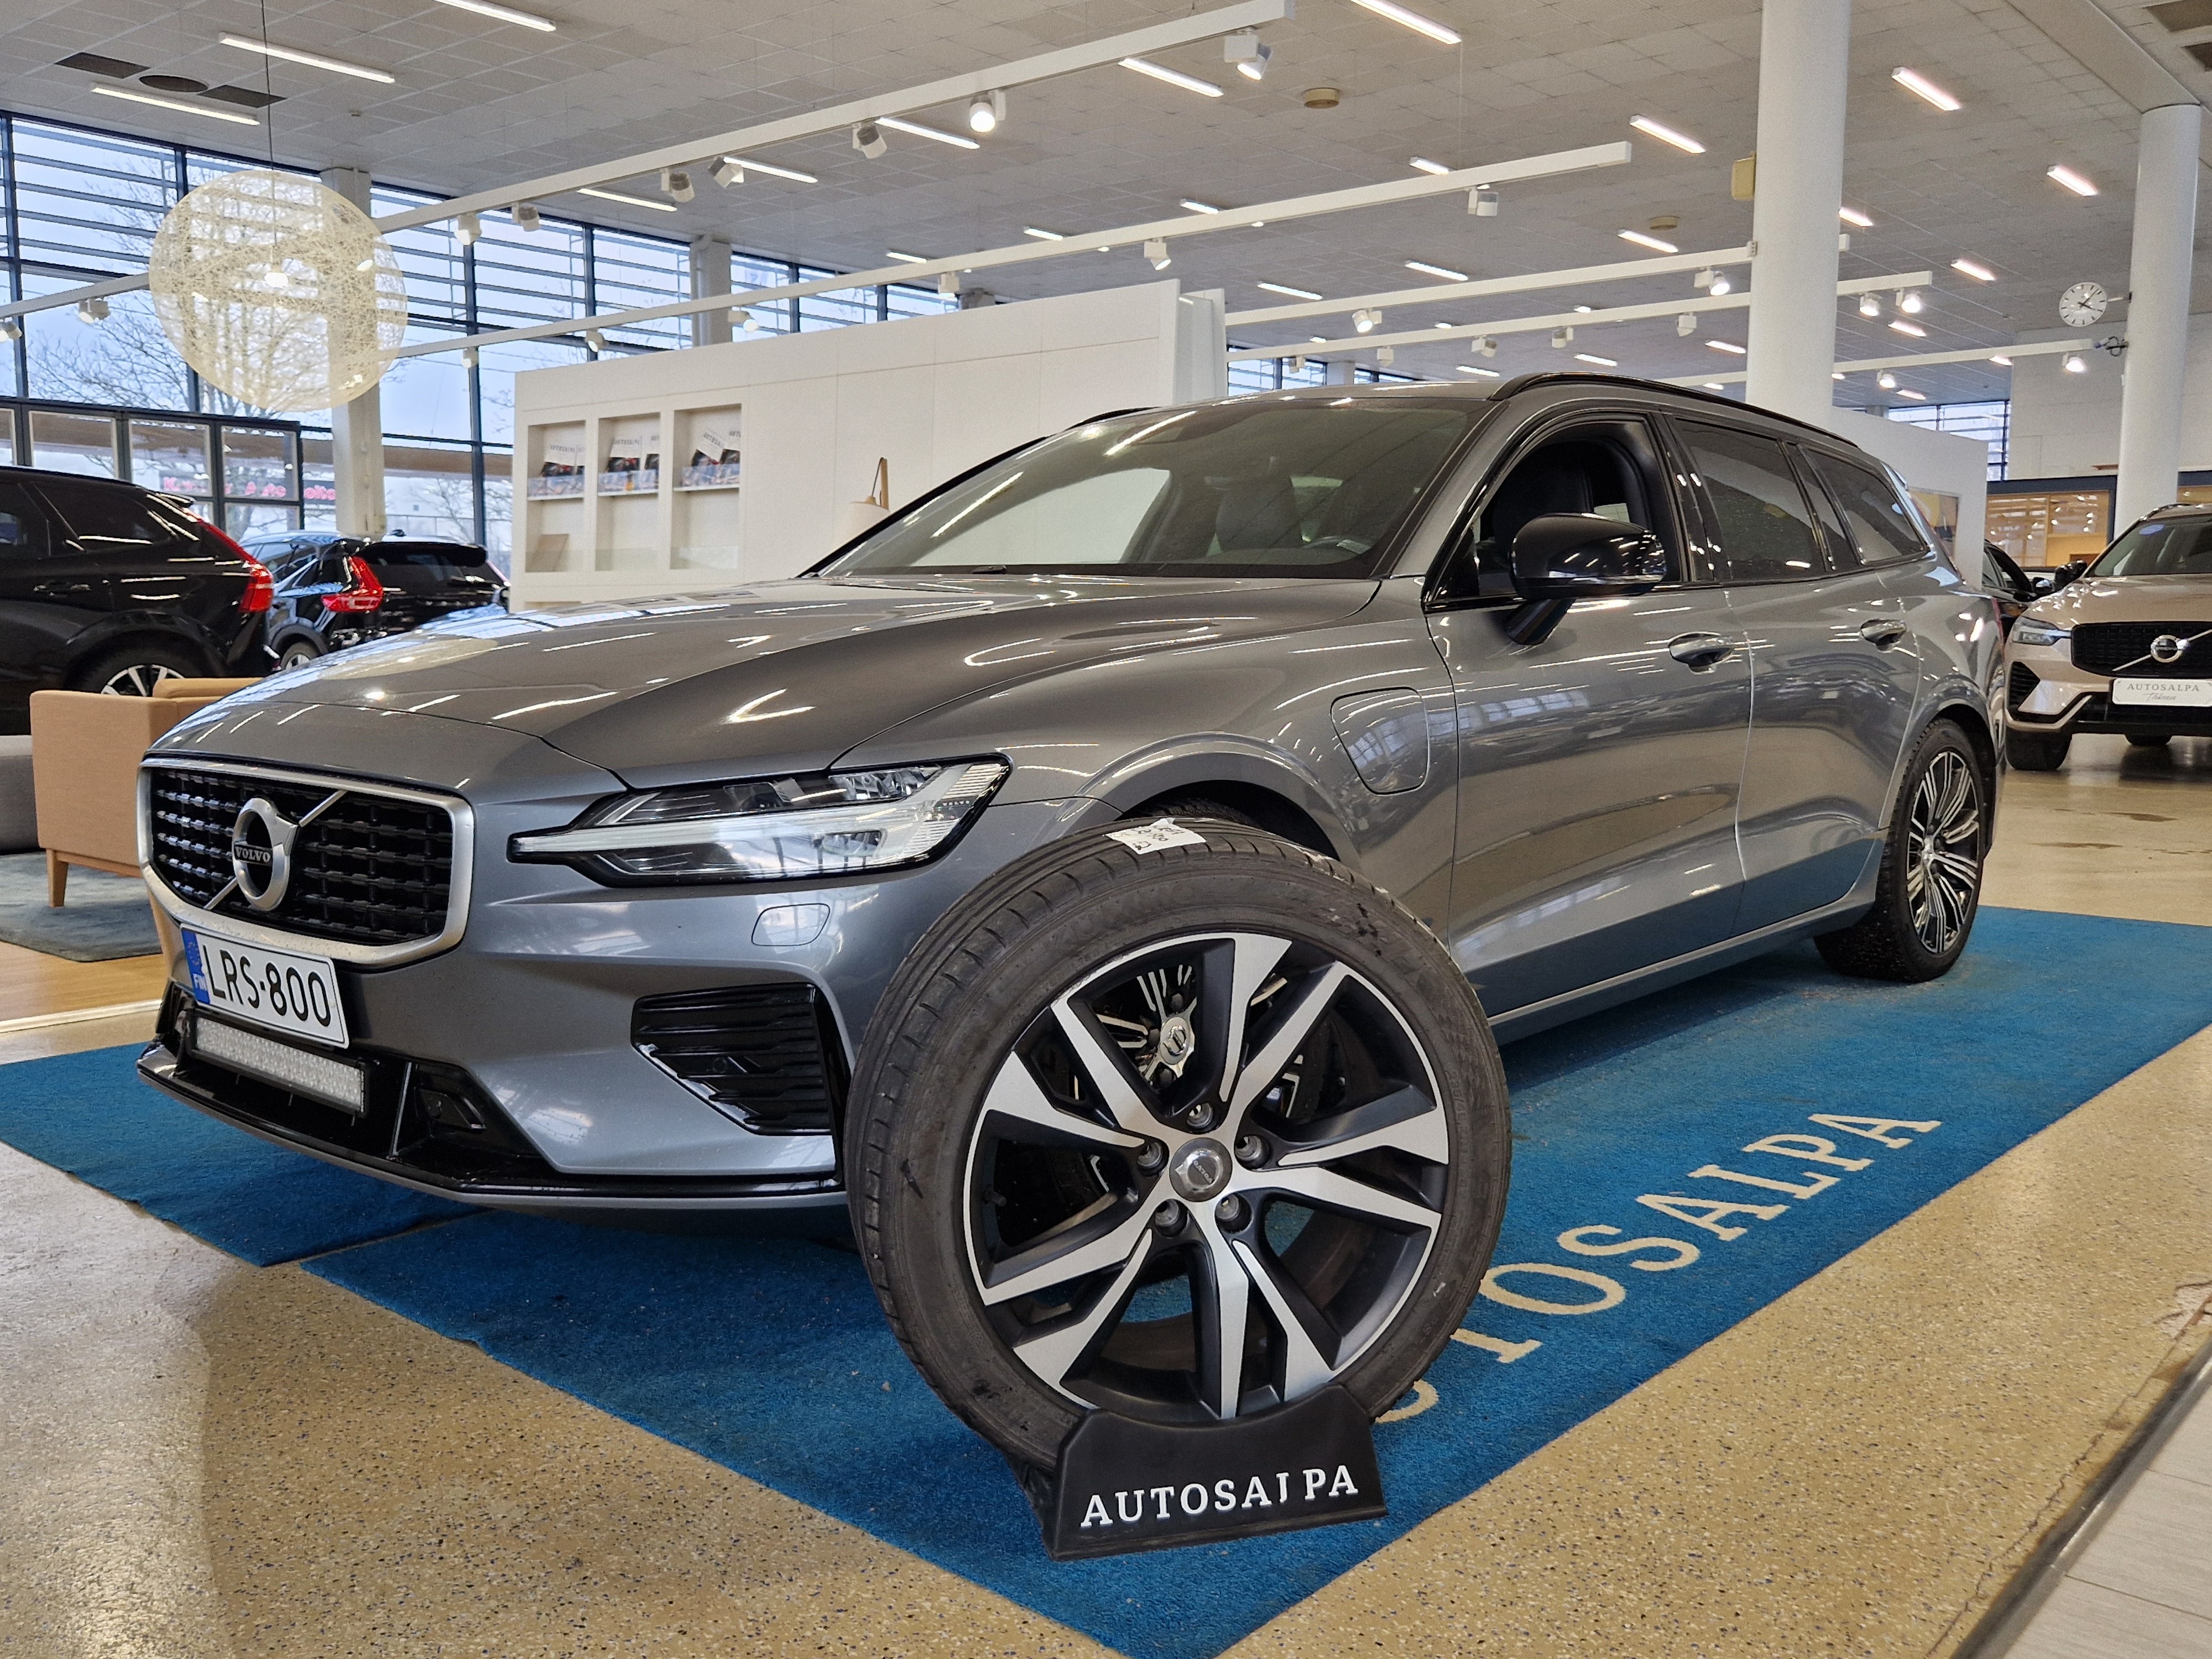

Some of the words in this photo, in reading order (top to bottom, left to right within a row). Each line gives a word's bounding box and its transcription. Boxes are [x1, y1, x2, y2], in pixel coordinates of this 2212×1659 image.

[234, 846, 271, 863] VOLVO
[202, 945, 331, 1027] LRS-800
[1193, 1160, 1213, 1184] VOLVO
[1375, 1113, 1943, 1423] OSALPA
